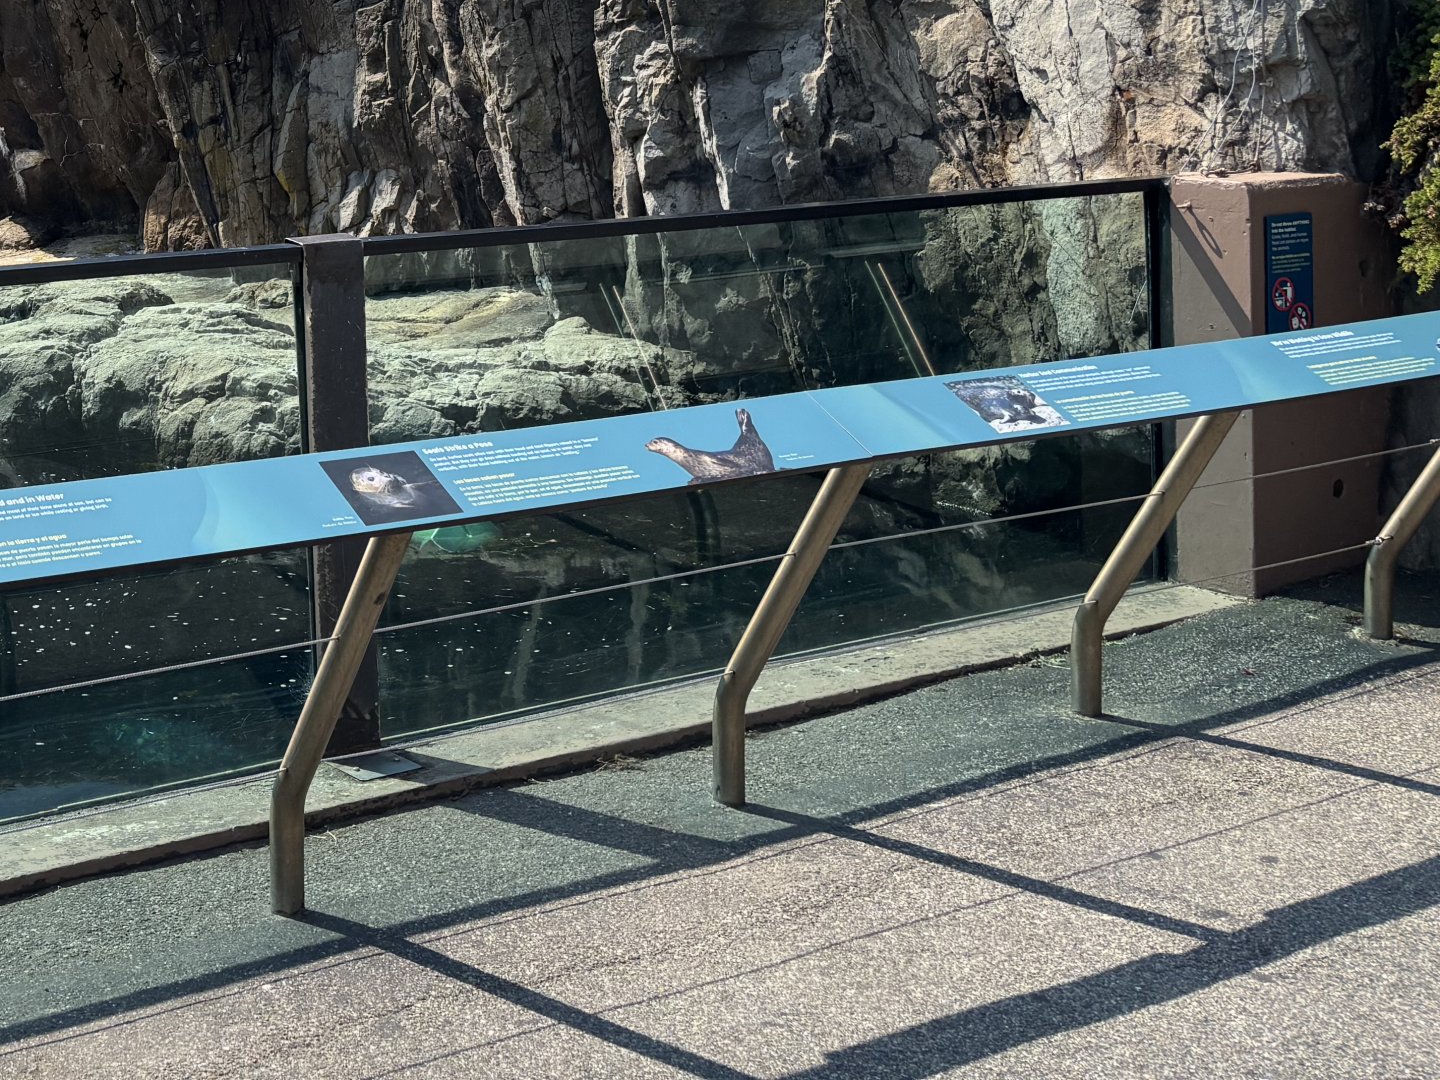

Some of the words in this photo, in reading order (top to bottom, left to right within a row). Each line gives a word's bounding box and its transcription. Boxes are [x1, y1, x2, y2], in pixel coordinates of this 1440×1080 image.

[6, 496, 25, 505] and
[25, 495, 35, 503] in
[35, 493, 64, 501] Water
